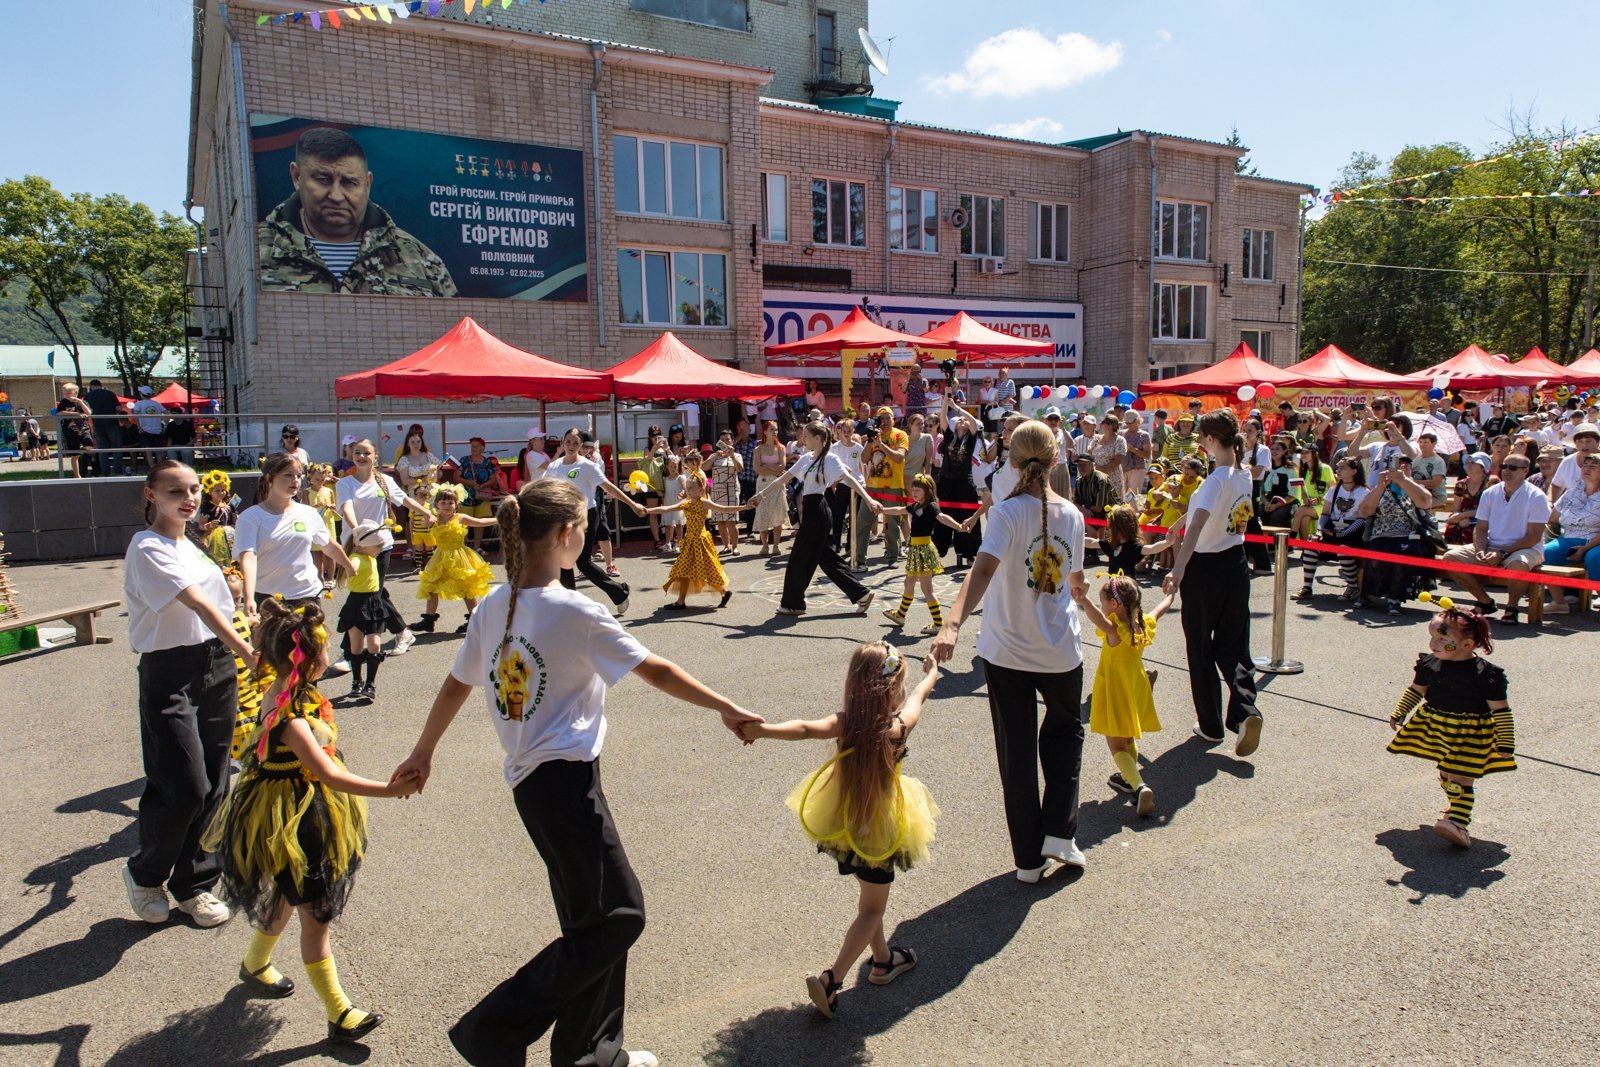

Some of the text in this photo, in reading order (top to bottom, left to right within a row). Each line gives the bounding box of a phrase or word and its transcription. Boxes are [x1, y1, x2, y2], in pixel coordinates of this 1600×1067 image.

[430, 184, 574, 206] ГЕРОЙ РОССИИ. ГЕРОЙ ПРИМОРЬЯ
[429, 201, 576, 227] СЕРГЕЙ ВИКТОРОВИЧ
[461, 223, 549, 248] ЕФРЕМОВ
[481, 251, 535, 264] ПОЛКОВНИК
[470, 266, 505, 276] 05.08.1973
[510, 268, 545, 278] 02.02.2025
[980, 322, 1051, 338] ИНСТВА
[523, 672, 547, 721] РАЗДОЛЬЕ
